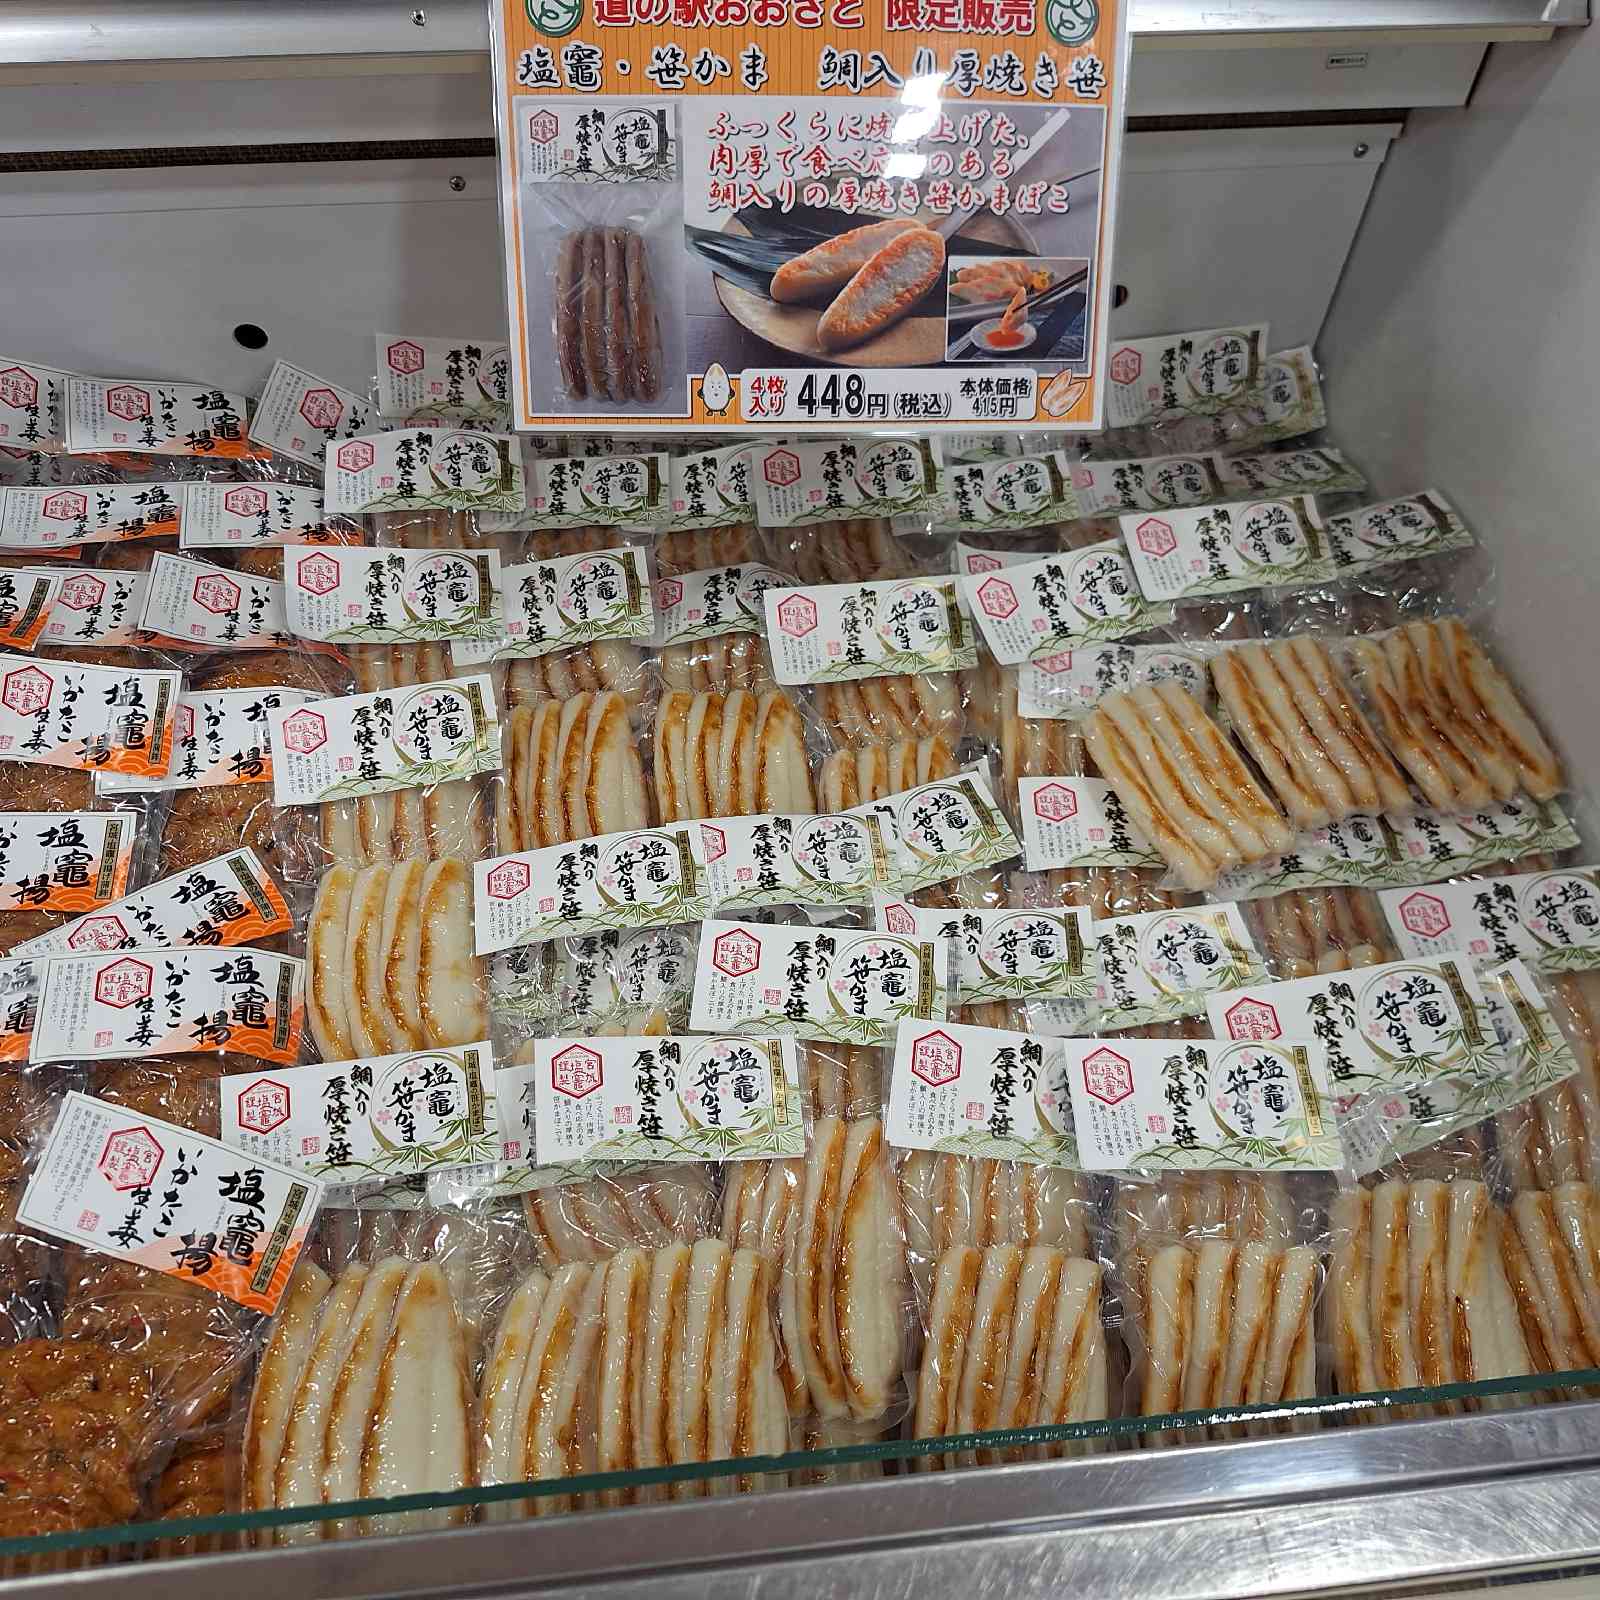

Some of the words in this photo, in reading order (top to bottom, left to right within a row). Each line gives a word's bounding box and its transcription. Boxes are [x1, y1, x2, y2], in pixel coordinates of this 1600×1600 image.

[594, 0, 864, 27] 道の駅おおさと
[887, 0, 1034, 31] 限定販売
[575, 114, 592, 174] 厚焼き笹
[591, 108, 605, 143] 鯛入り
[611, 123, 633, 163] 笹かま
[708, 110, 1031, 148] ふっくらに焼上げた、
[707, 180, 1068, 213] 鯛入りの厚焼き笹かまぼこ
[960, 378, 1031, 396] 本体価格
[971, 397, 1017, 417] 415円
[396, 439, 417, 498] 厚焼き笹
[415, 432, 433, 465] 鯛入り
[441, 445, 468, 487] 笹かま
[568, 459, 584, 487] 鯛入り
[702, 456, 718, 487] 鯛入り
[840, 444, 857, 477] 鯛入り
[548, 463, 568, 515] 厚焼き笹
[593, 469, 617, 504] 笹かま
[683, 463, 707, 516] 厚焼き笹
[730, 462, 750, 502] 笹かま
[820, 450, 846, 510] 厚焼き笹
[866, 456, 892, 498] 笹かま
[364, 561, 388, 630] 厚焼き笹
[386, 552, 405, 594] 鯛入り
[416, 570, 445, 618] 笹かま
[538, 565, 557, 605] 鯛入り
[568, 575, 594, 619] 笹かま
[518, 575, 547, 643] 厚焼き笹
[840, 596, 866, 666] 厚焼き笹
[859, 587, 879, 628] 鯛入り
[887, 603, 914, 651] 笹かま
[373, 696, 393, 739] 鯛入り
[405, 706, 437, 760] 笹かま
[351, 705, 382, 781] 厚焼き笹
[772, 816, 793, 854] 鯛入り
[807, 829, 834, 881] 笹かま
[912, 809, 946, 853] 笹かま
[579, 842, 600, 881] 鯛入り
[613, 851, 643, 902] 笹かま
[750, 823, 780, 891] 厚焼き笹
[556, 853, 583, 921] 厚焼き笹
[814, 932, 836, 980] 鯛入り
[961, 913, 983, 956] 鯛入り
[997, 932, 1028, 976] 笹かま
[783, 940, 814, 1023] 厚焼き笹
[842, 956, 880, 1017] 笹かま
[1328, 981, 1357, 1030] 鯛入り
[1304, 992, 1355, 1080] 厚焼き笹
[1374, 991, 1416, 1054] 笹かま
[658, 1037, 682, 1093] 鯛入り
[1020, 1038, 1043, 1094] 鯛入り
[1185, 1044, 1210, 1101] 鯛入り
[350, 1064, 373, 1117] 鯛入り
[385, 1076, 425, 1144] 笹かま
[631, 1049, 665, 1142] 厚焼き笹
[693, 1056, 730, 1127] 笹かま
[987, 1047, 1019, 1142] 厚焼き笹
[1161, 1055, 1200, 1151] 厚焼き笹
[1223, 1067, 1258, 1136] 笹かま
[320, 1075, 353, 1168] 厚焼き笹
